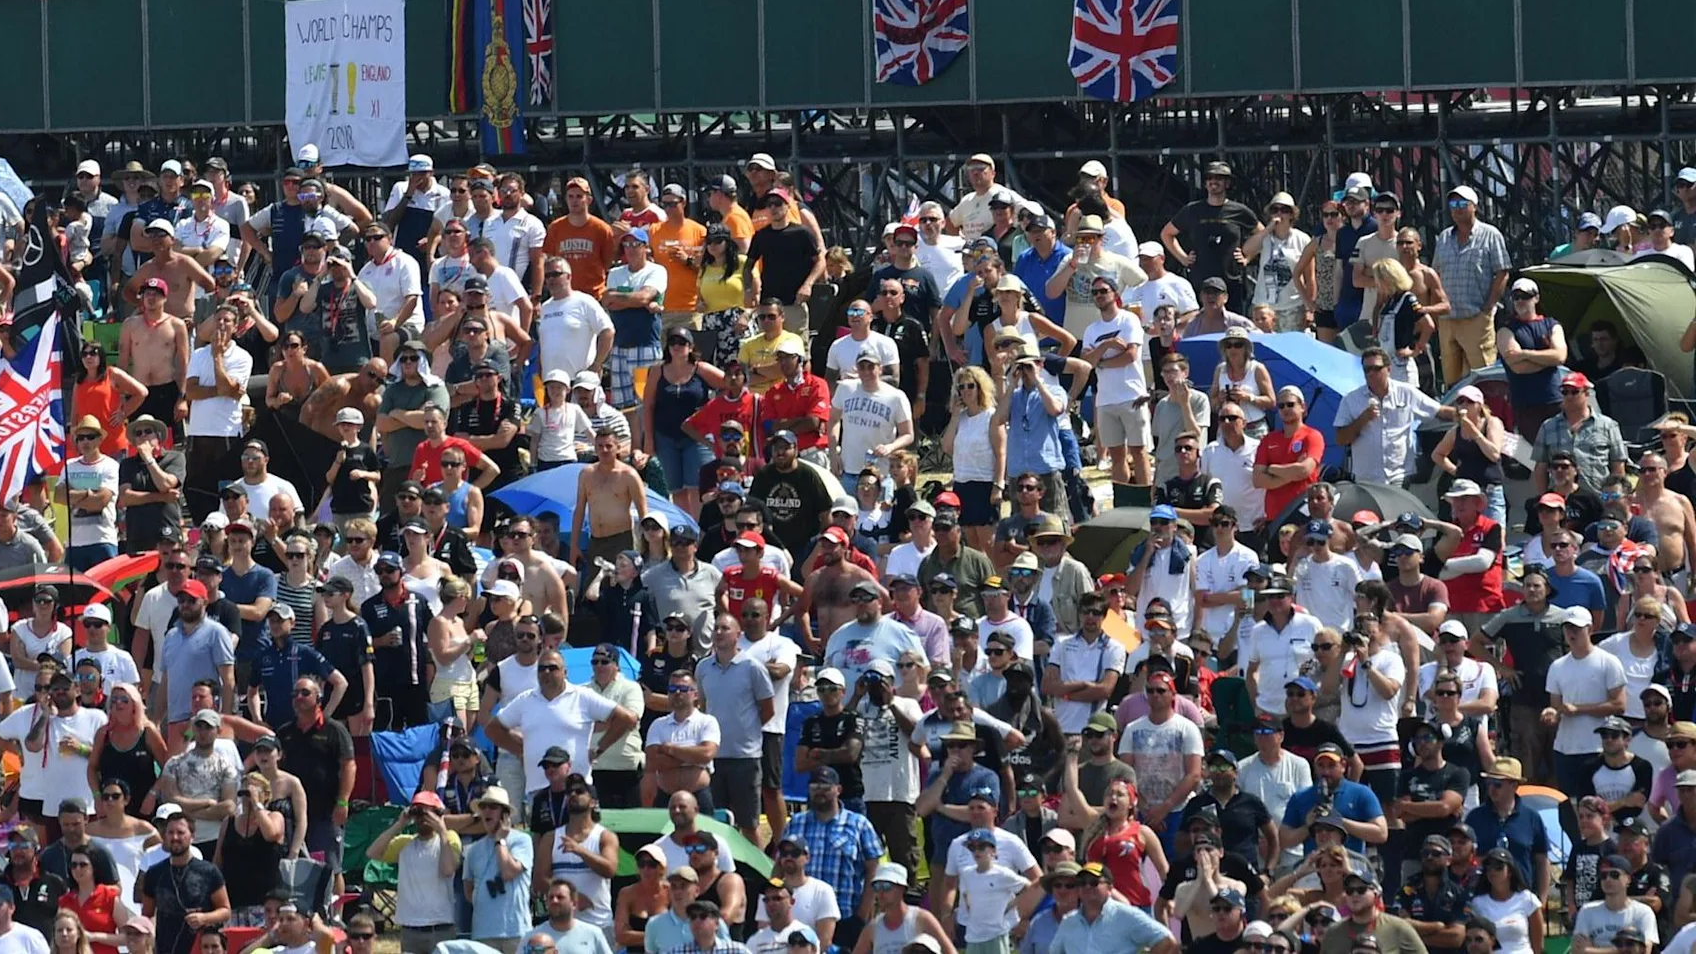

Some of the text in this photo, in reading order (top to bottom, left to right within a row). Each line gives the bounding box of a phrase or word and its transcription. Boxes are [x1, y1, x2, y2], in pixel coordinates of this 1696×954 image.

[297, 13, 393, 44] WORLD CHAMPS
[361, 64, 392, 82] ENGLAND
[559, 238, 593, 253] AUSTIN
[844, 397, 892, 422] HILFIGER
[847, 415, 881, 428] DENIM
